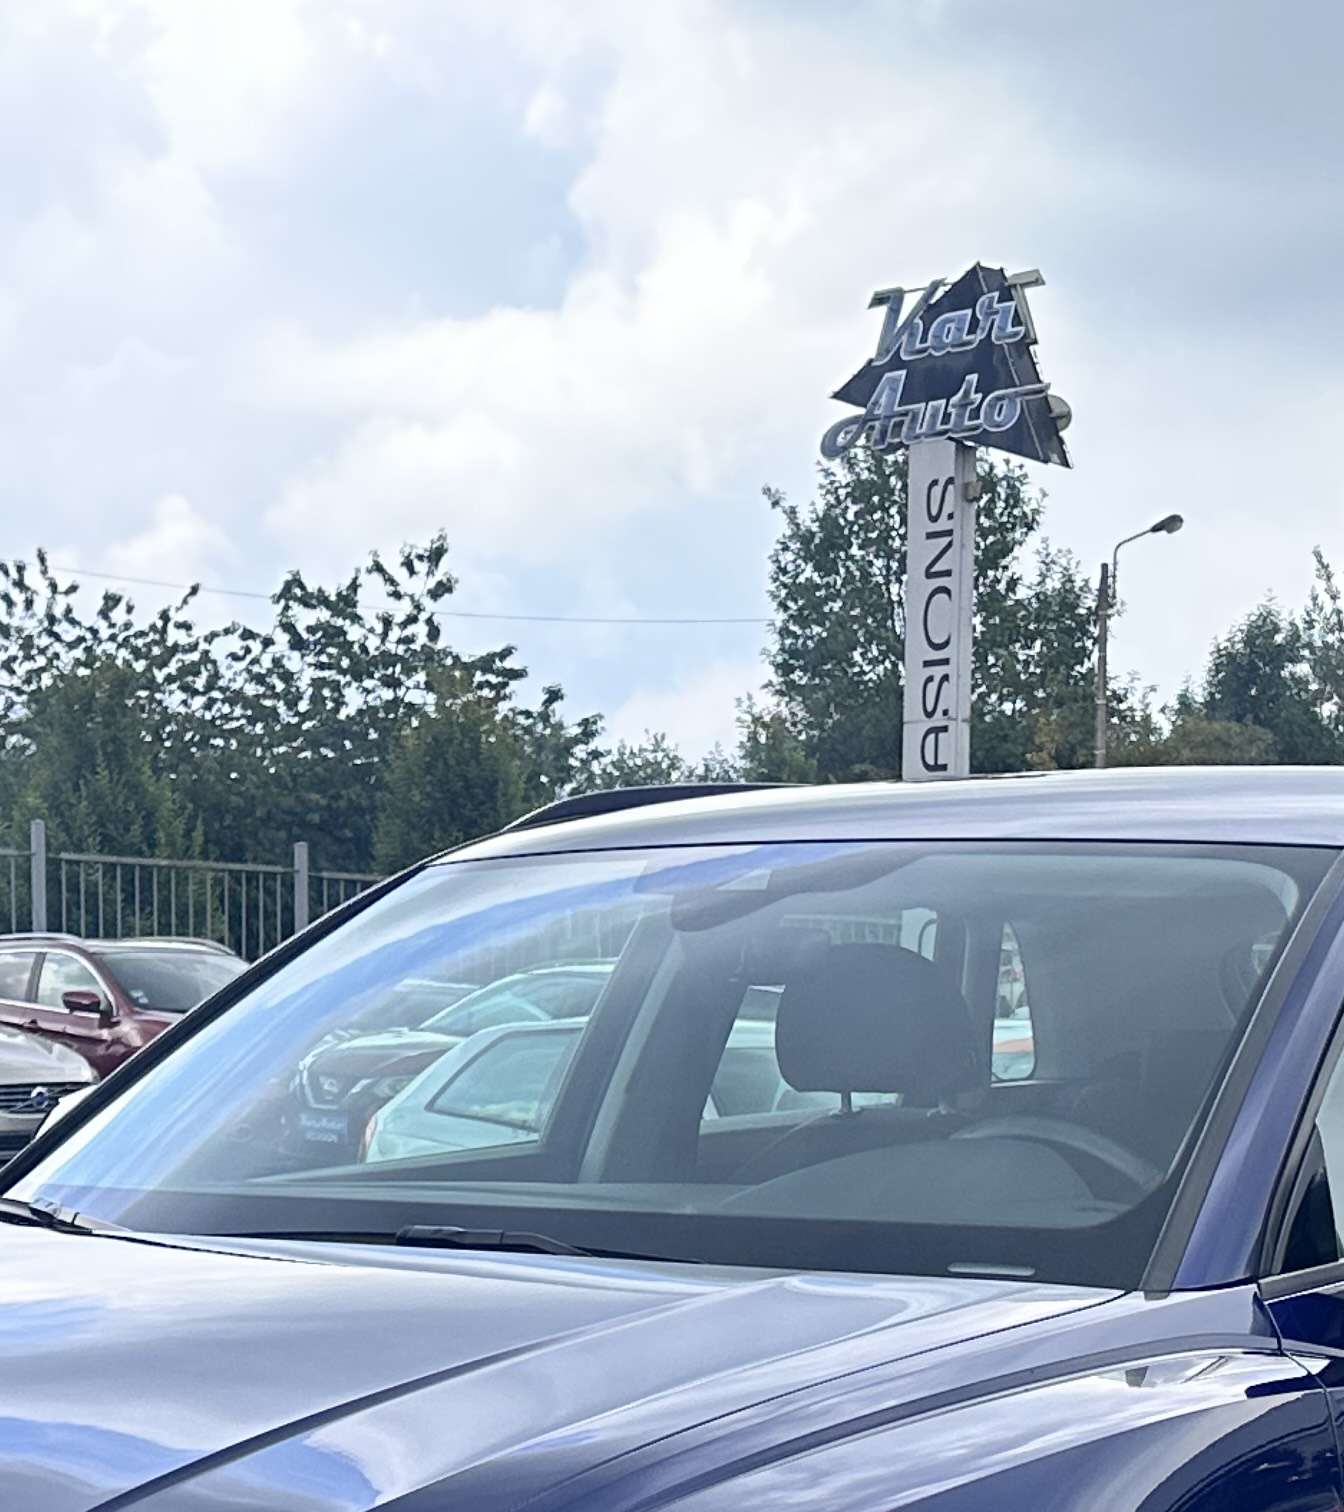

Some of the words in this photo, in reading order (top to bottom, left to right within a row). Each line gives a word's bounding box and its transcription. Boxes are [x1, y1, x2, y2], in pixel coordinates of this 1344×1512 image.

[867, 277, 1026, 367] Kar
[819, 368, 1051, 461] Auto
[919, 474, 956, 774] ASIONS
